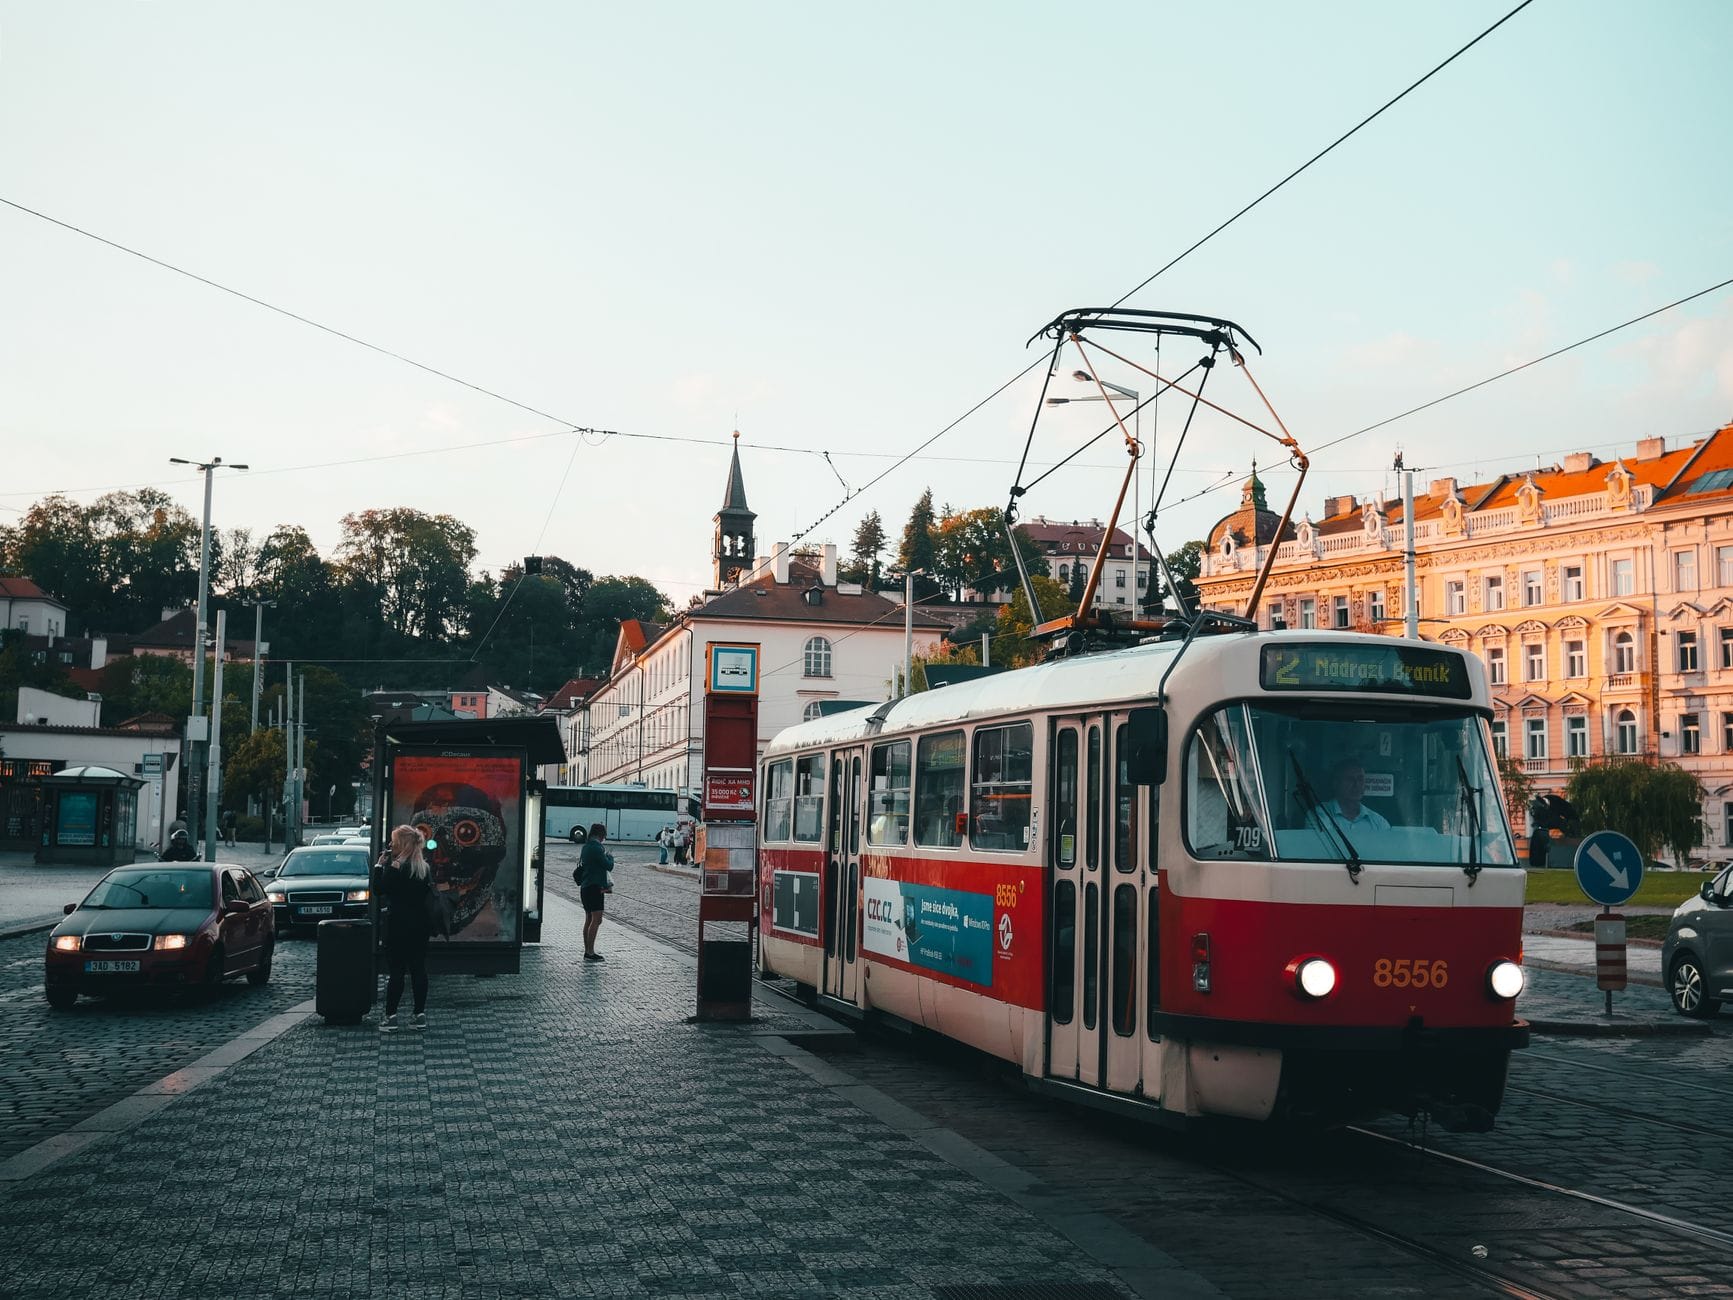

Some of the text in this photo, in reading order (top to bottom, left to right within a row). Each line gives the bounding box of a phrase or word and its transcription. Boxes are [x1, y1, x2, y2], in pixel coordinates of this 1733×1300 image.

[1276, 654, 1300, 684] 2
[1236, 826, 1261, 847] 709
[921, 898, 932, 914] Jsme
[996, 883, 1017, 908] 8556
[92, 961, 109, 971] 3AD
[1373, 958, 1448, 989] 8556
